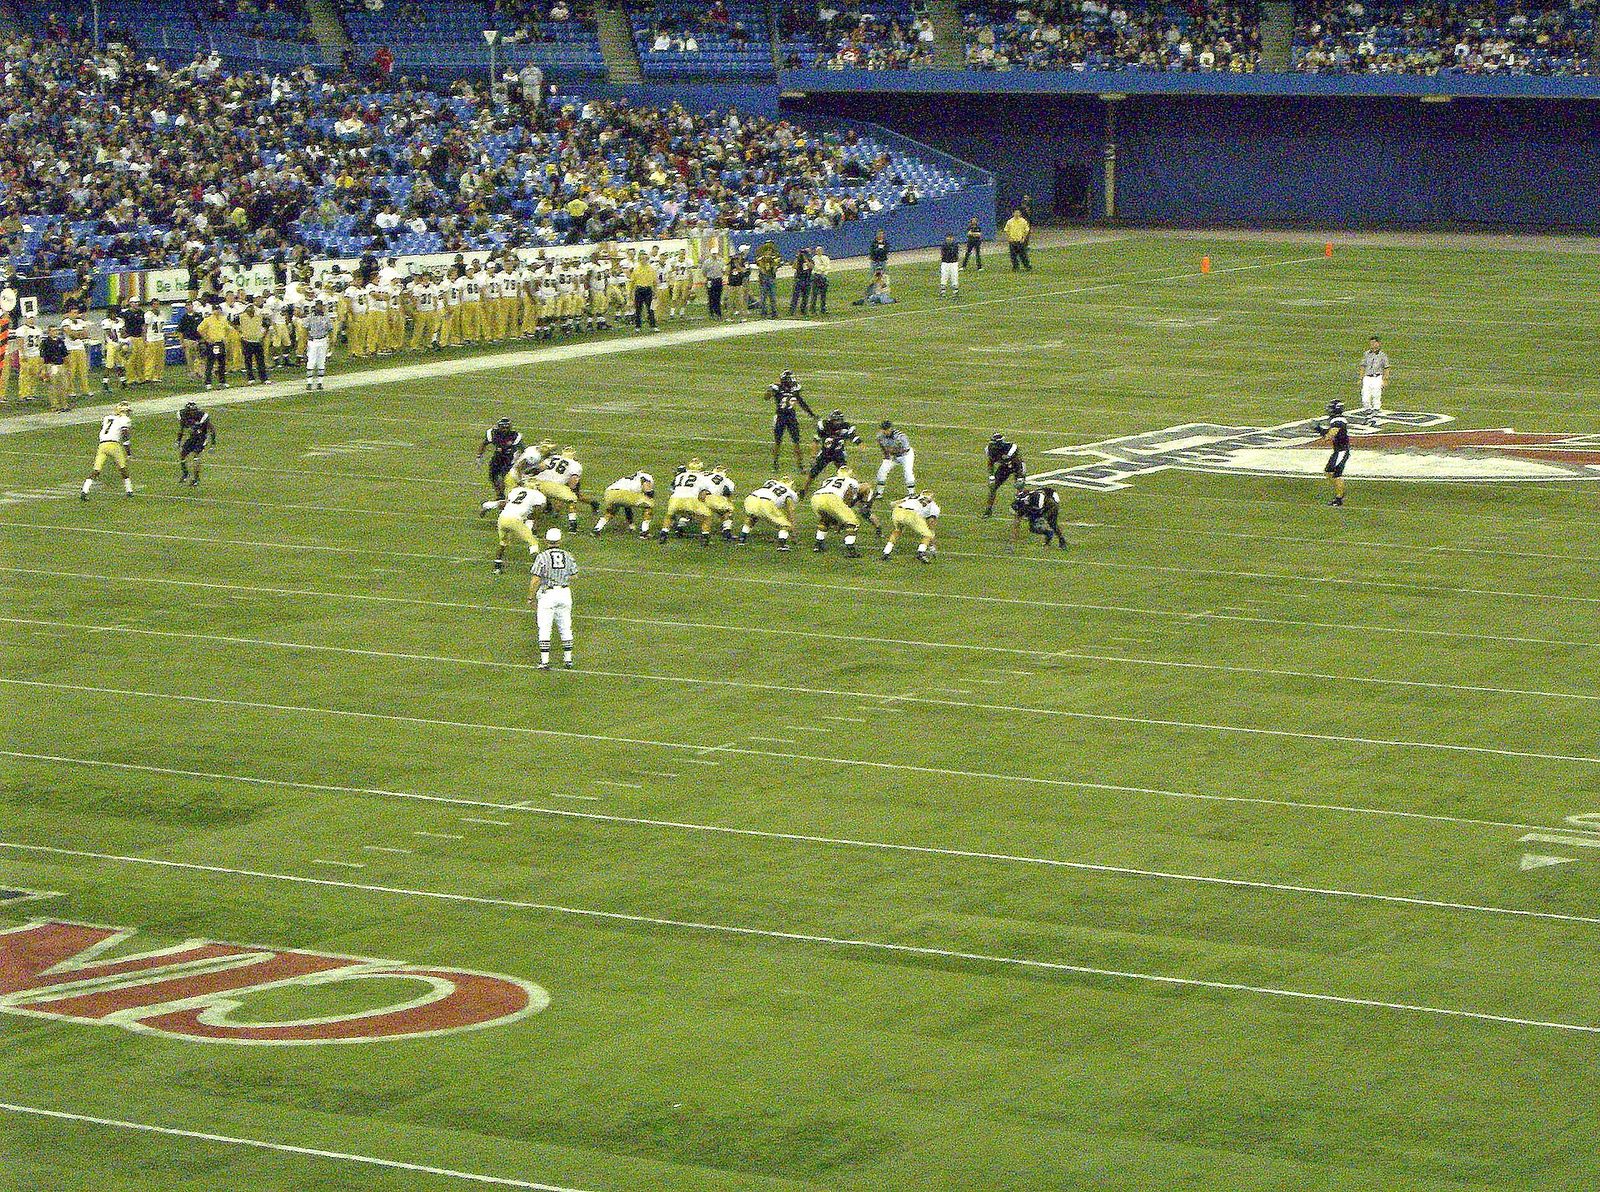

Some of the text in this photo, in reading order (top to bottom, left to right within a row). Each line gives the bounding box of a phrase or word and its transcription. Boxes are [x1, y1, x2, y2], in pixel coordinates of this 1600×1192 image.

[104, 418, 114, 434] 7
[546, 456, 569, 475] 56
[674, 474, 698, 488] 12
[511, 490, 528, 505] 2
